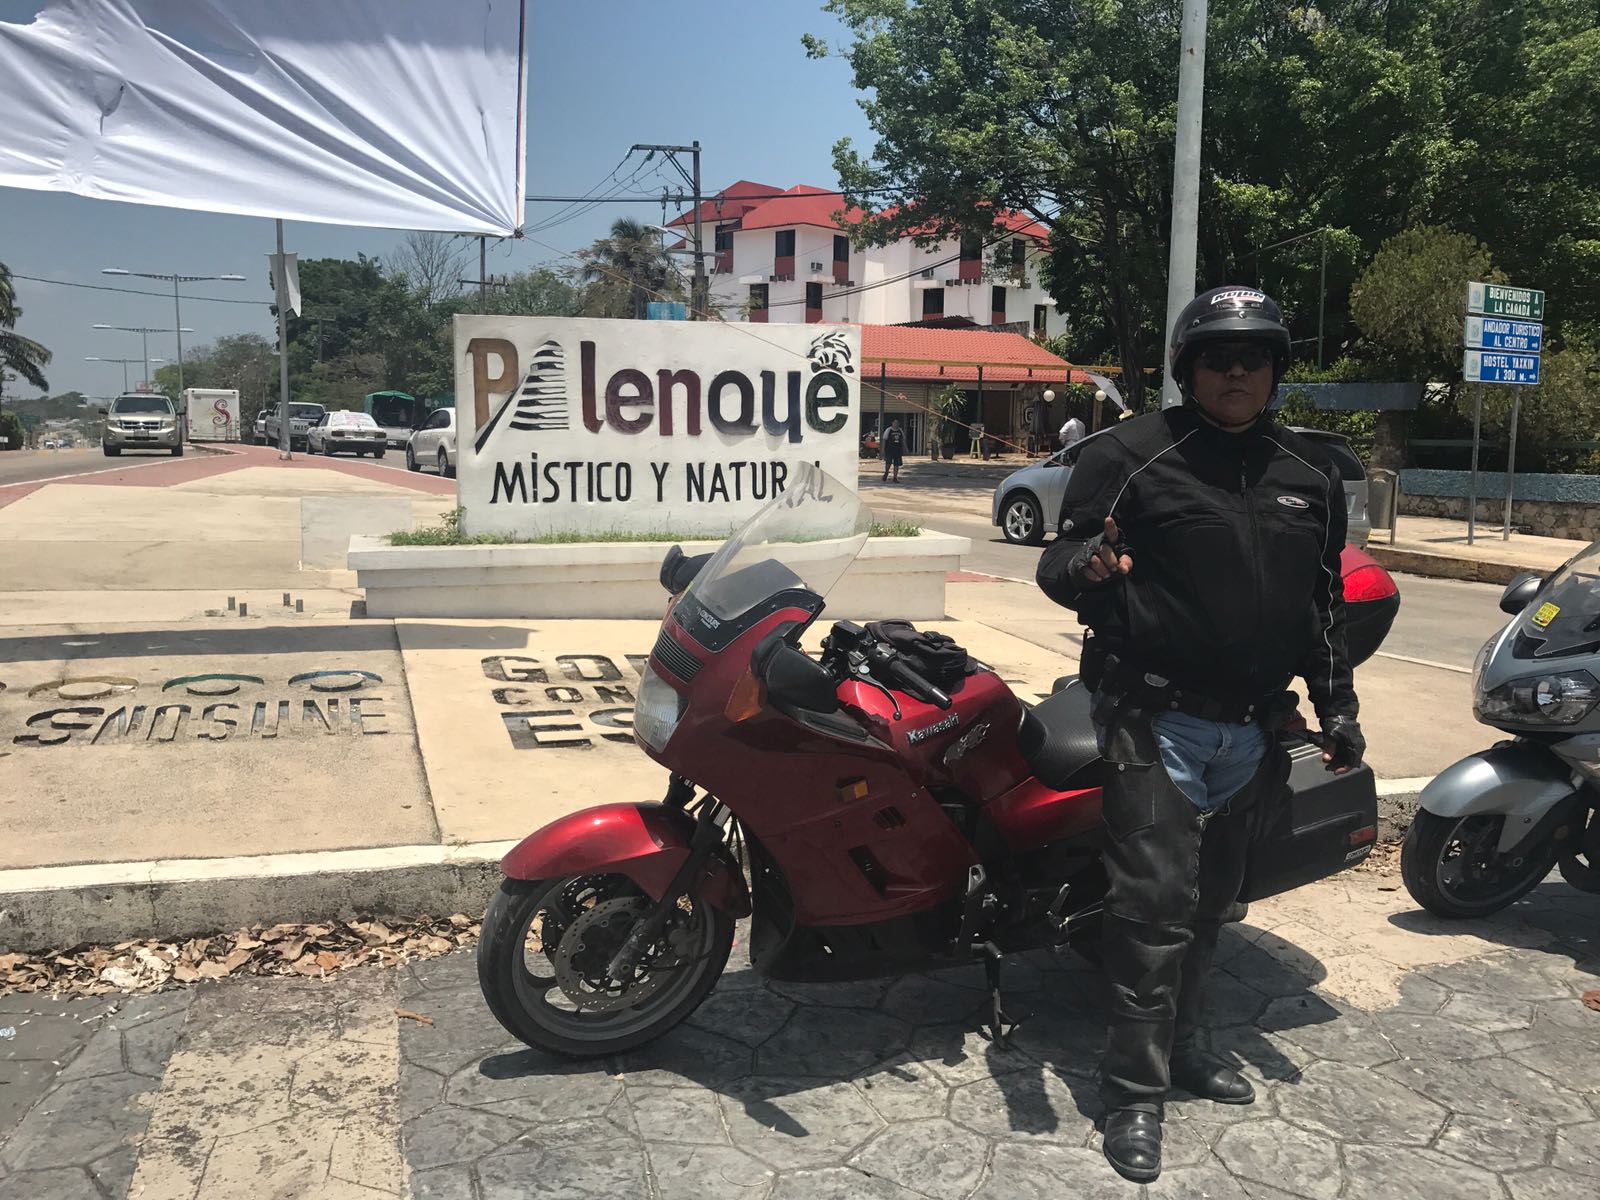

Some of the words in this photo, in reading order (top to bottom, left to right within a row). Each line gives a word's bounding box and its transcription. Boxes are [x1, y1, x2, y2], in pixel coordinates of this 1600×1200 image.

[1489, 287, 1531, 303] BIENVENIDOS
[1534, 293, 1539, 305] A
[1494, 301, 1503, 313] LA
[1484, 319, 1510, 335] ANDADOR
[1494, 335, 1502, 347] AL
[1504, 336, 1528, 349] CENTRO
[1483, 355, 1509, 368] HOSTEL
[1495, 368, 1500, 380] A
[1503, 369, 1516, 381] 300
[650, 461, 671, 503] Y
[906, 712, 960, 744] Kawasaki
